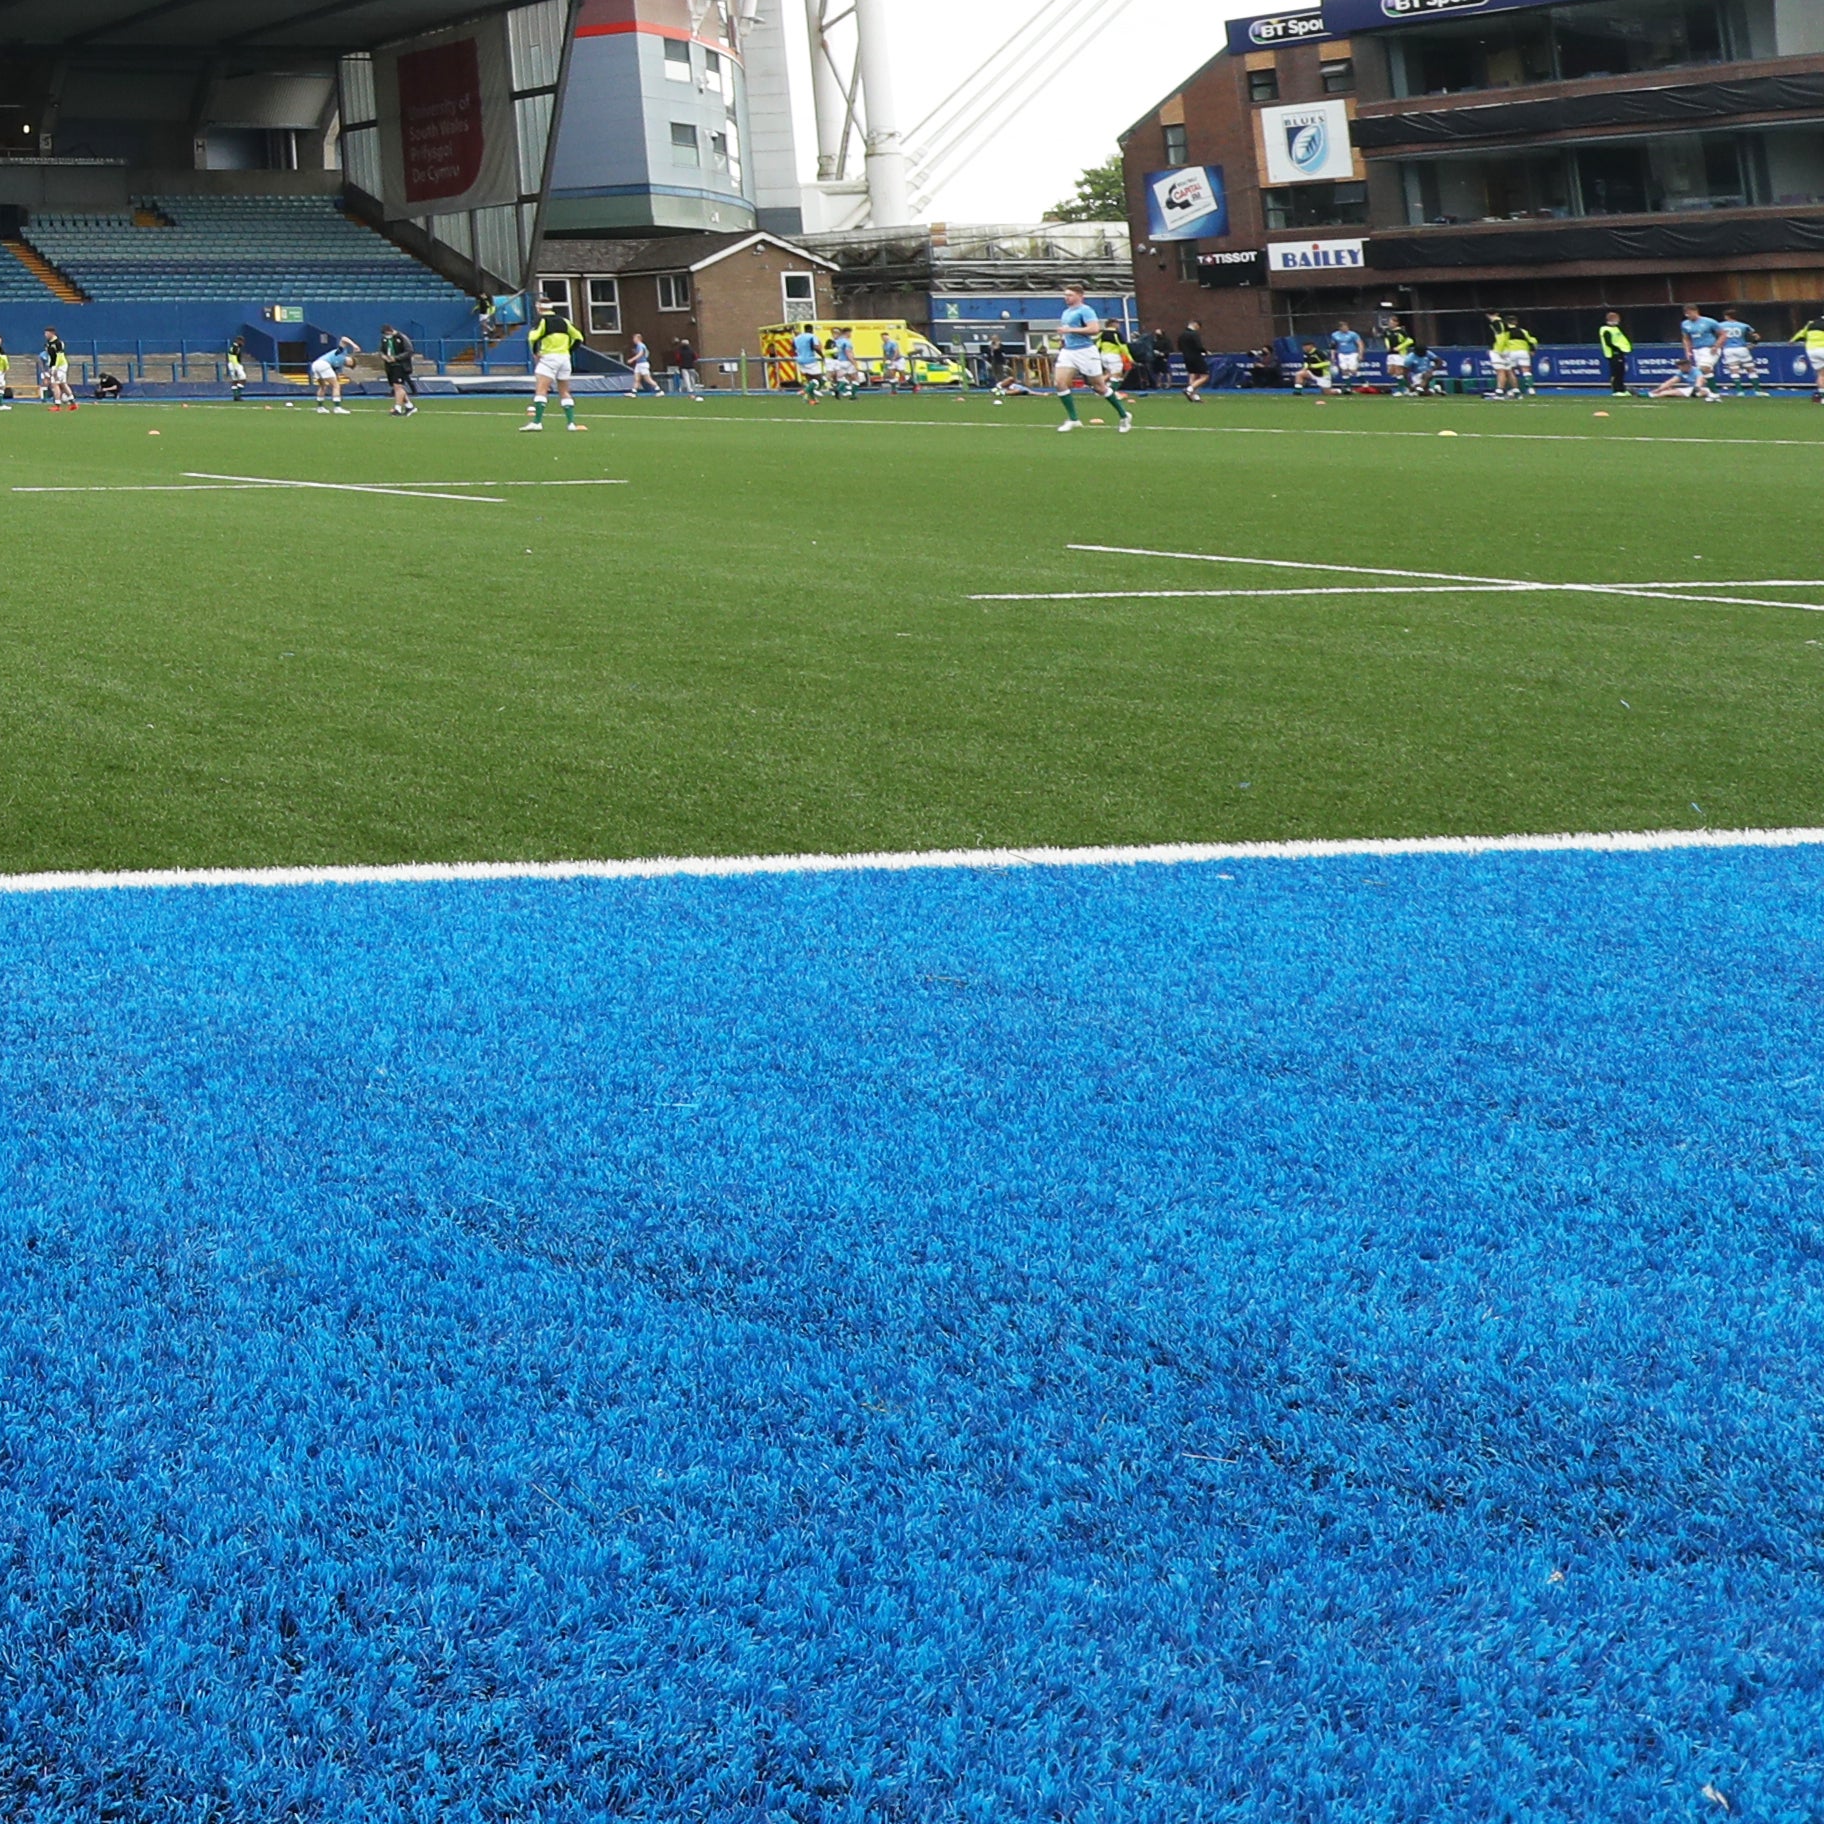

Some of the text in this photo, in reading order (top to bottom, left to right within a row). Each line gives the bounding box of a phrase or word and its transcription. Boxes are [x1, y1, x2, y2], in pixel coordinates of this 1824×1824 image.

[1261, 23, 1286, 38] BT
[1283, 115, 1326, 126] BLUES
[1174, 182, 1202, 200] CAPITAL
[1212, 251, 1258, 264] TISSOT
[1725, 327, 1742, 338] 20
